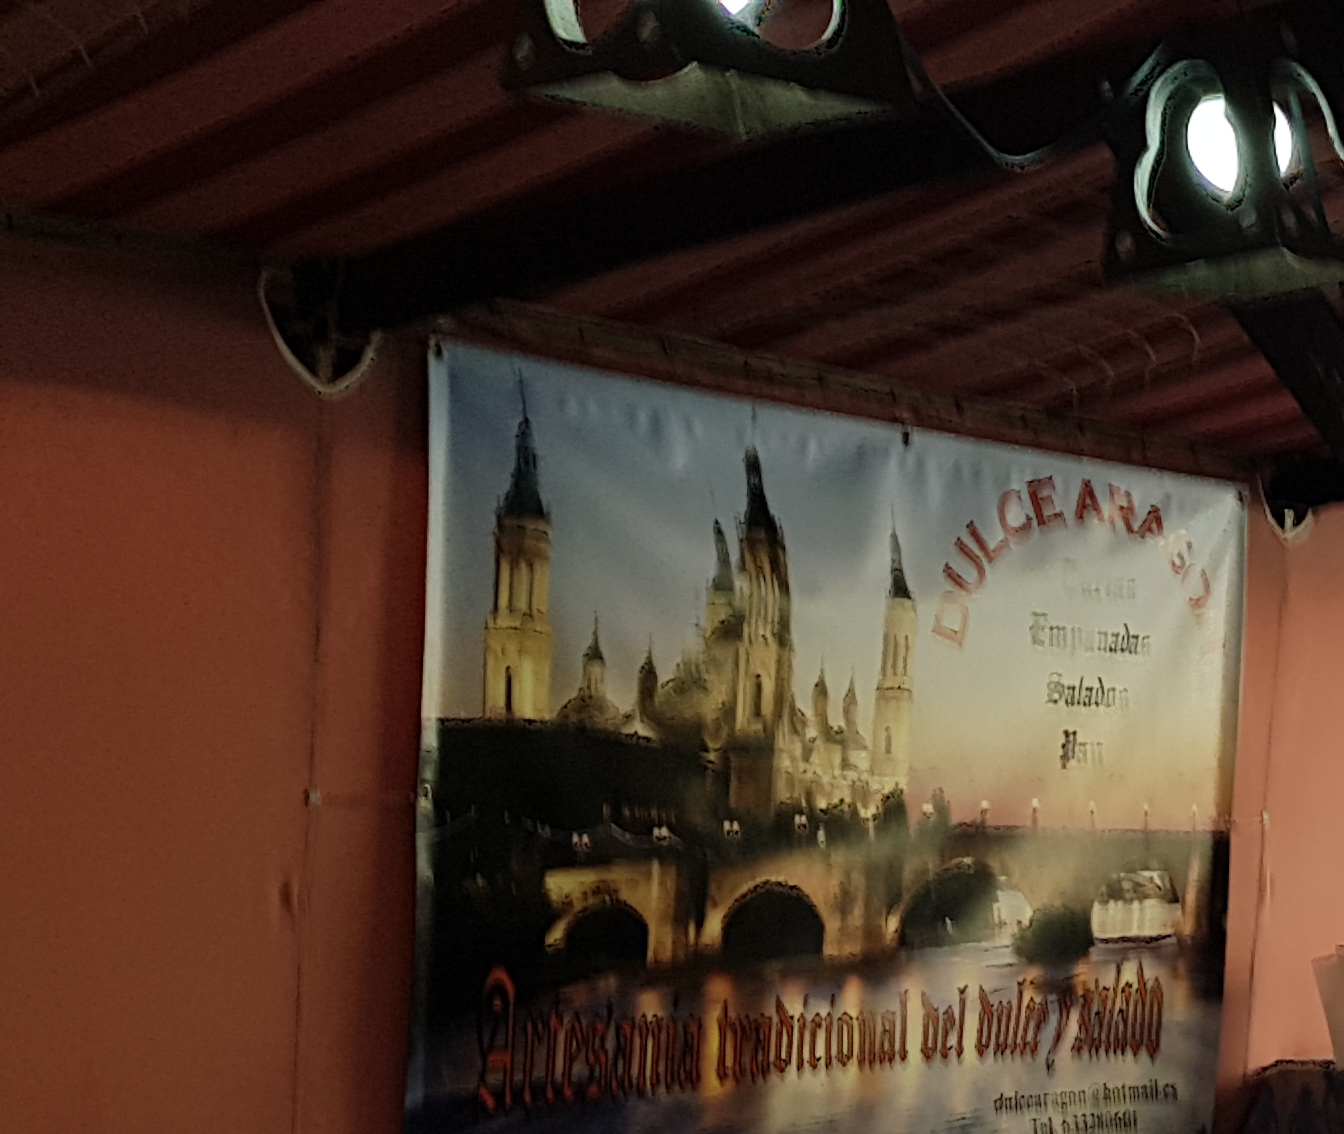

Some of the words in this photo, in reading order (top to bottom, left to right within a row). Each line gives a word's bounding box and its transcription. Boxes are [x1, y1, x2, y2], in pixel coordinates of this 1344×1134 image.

[931, 475, 1069, 649] DULCE
[1045, 672, 1130, 709] Salados
[1059, 729, 1104, 770] Pan
[920, 983, 969, 1065] del
